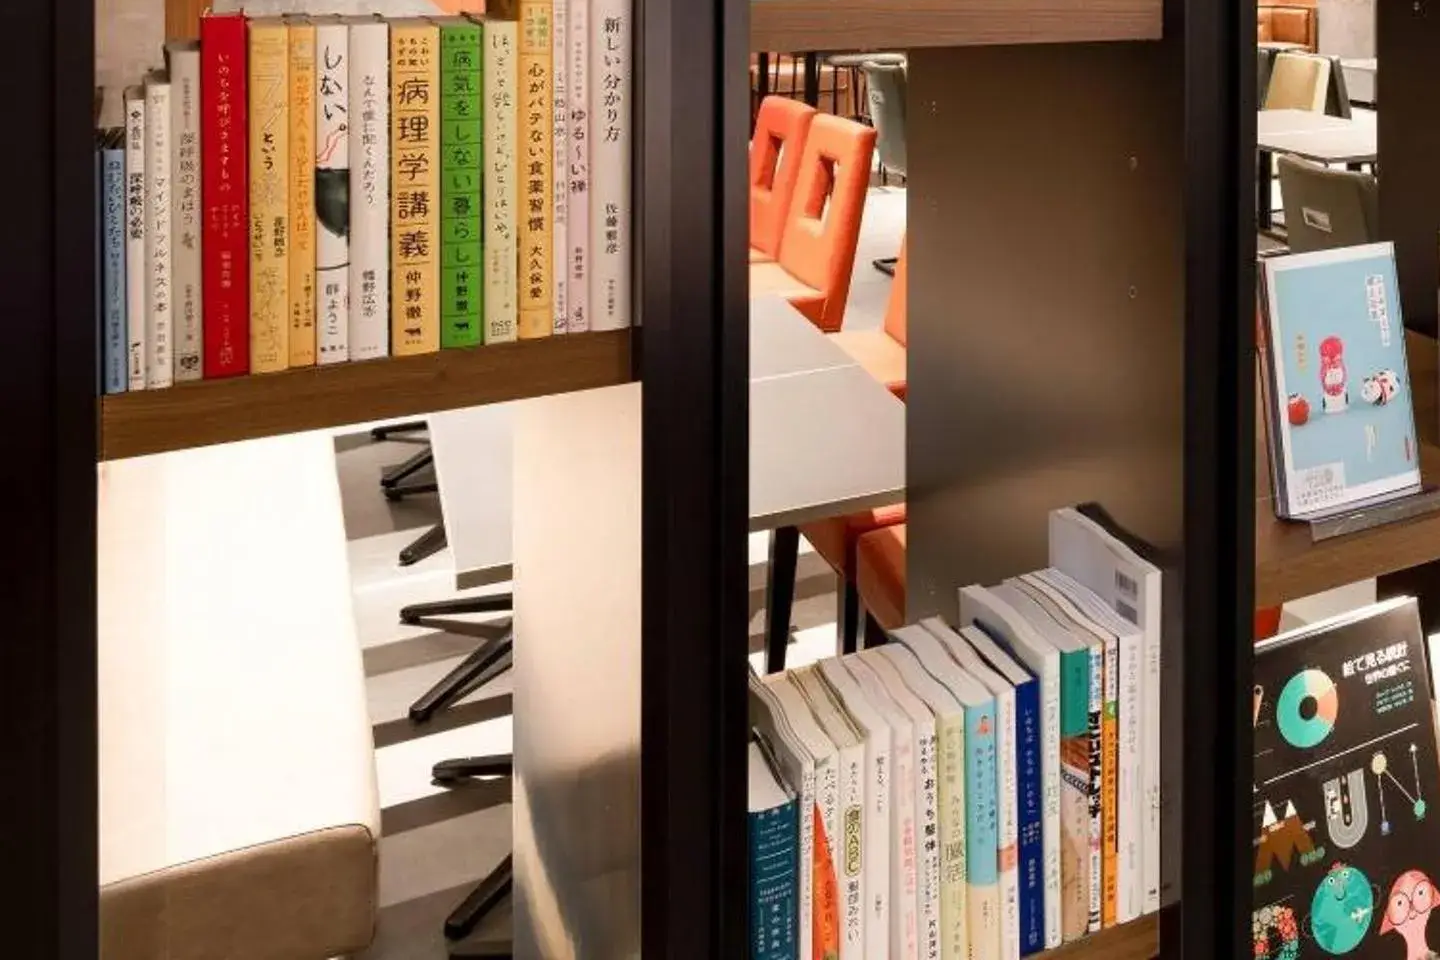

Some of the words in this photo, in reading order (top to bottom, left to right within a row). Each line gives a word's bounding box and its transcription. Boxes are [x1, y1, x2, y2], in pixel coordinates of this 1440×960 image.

[216, 52, 232, 191] いのちを呼びさますもの
[527, 62, 545, 232] 心がバテない食薬習慣
[604, 16, 622, 143] 新しい分かり方
[396, 76, 431, 259] 病理学講義
[451, 50, 472, 264] 病気をしない暮らし
[325, 283, 340, 336] 群ようこ
